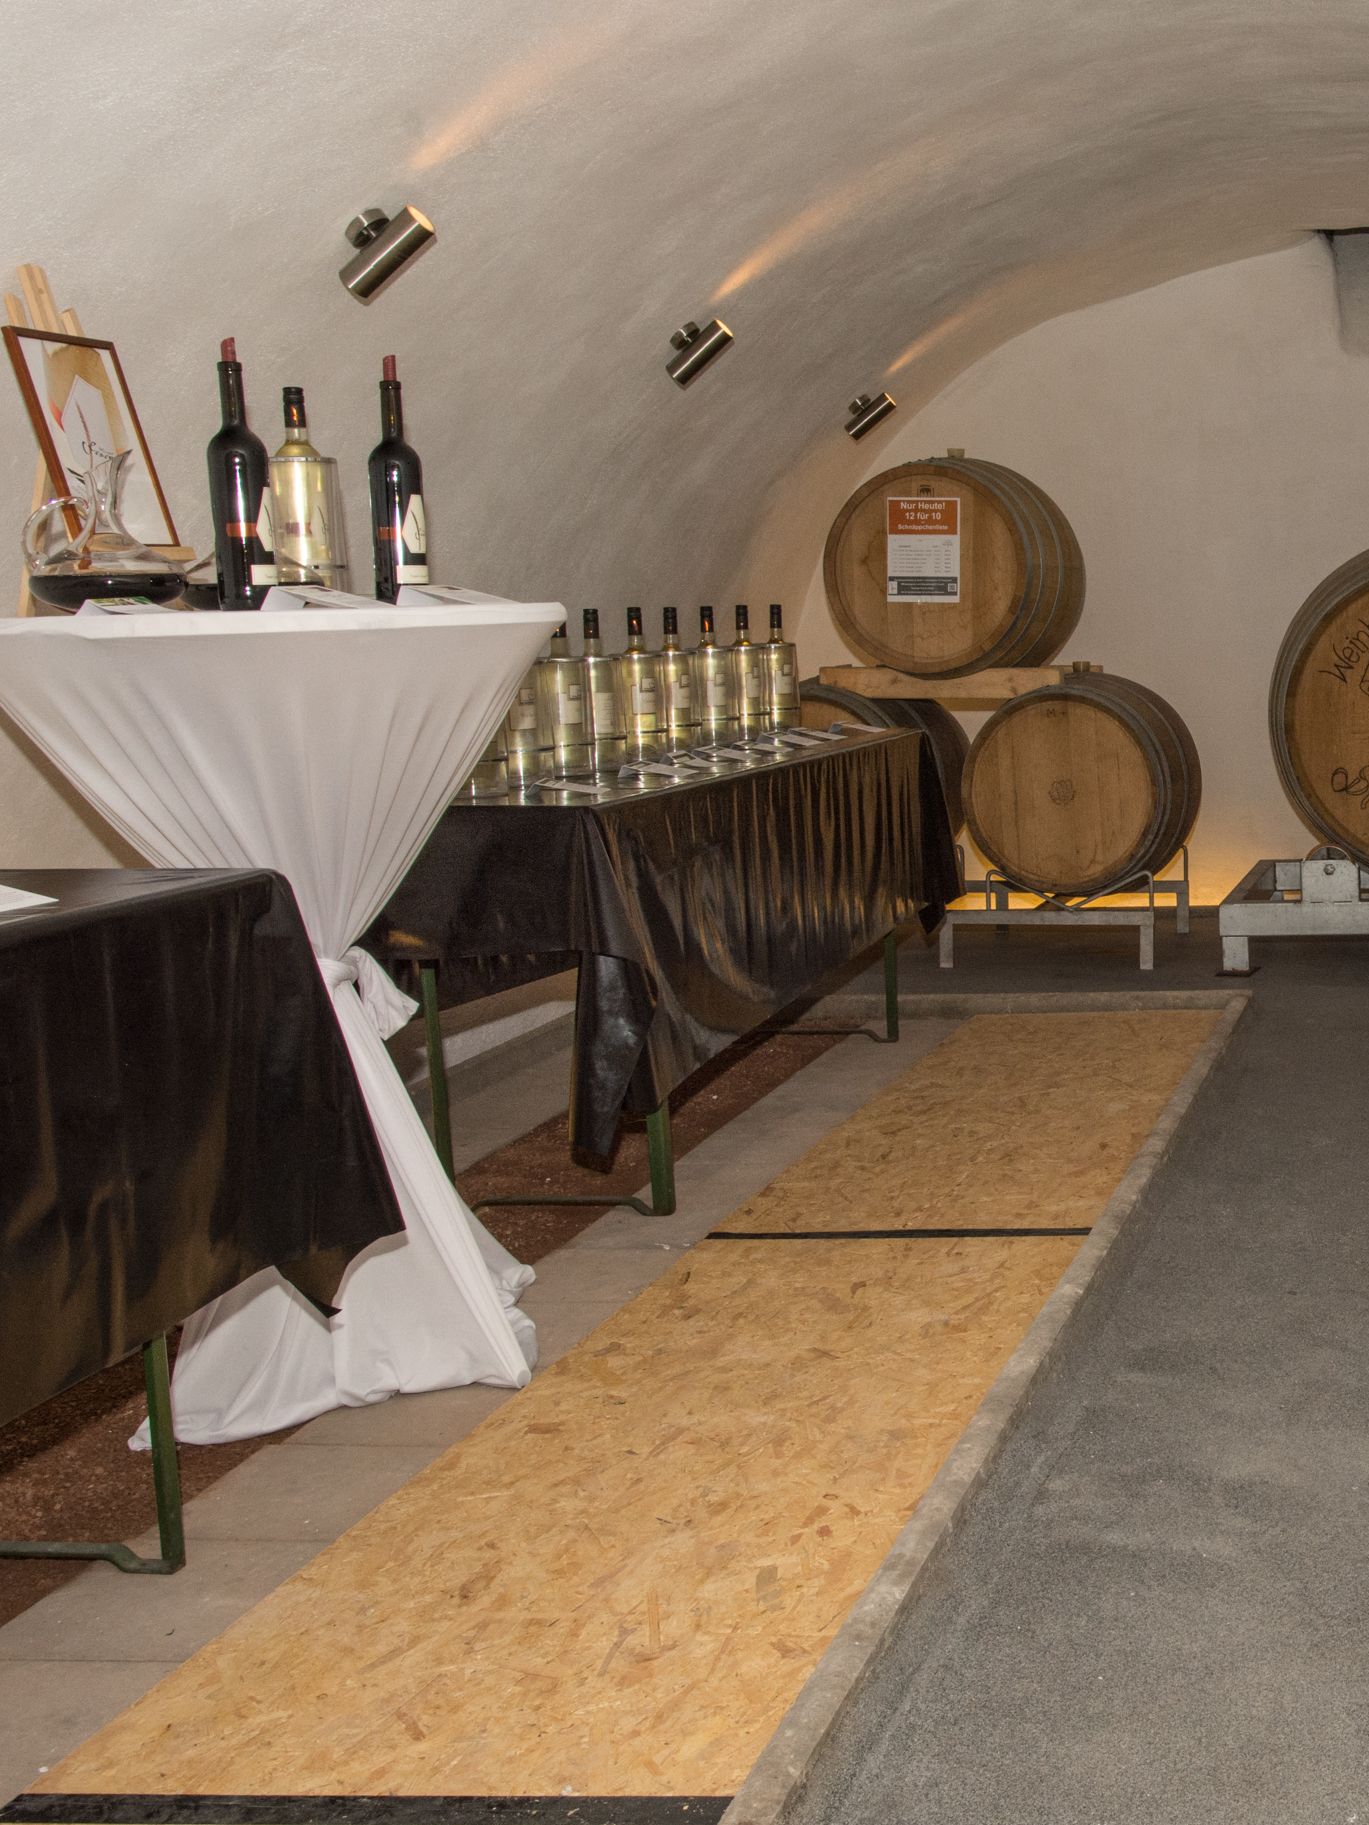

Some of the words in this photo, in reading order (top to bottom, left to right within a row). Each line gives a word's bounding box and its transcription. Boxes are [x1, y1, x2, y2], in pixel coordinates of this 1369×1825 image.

[900, 502, 916, 510] Nur
[918, 502, 945, 510] Heute!
[905, 512, 915, 520] 12
[916, 511, 929, 520] für
[931, 512, 941, 520] 10
